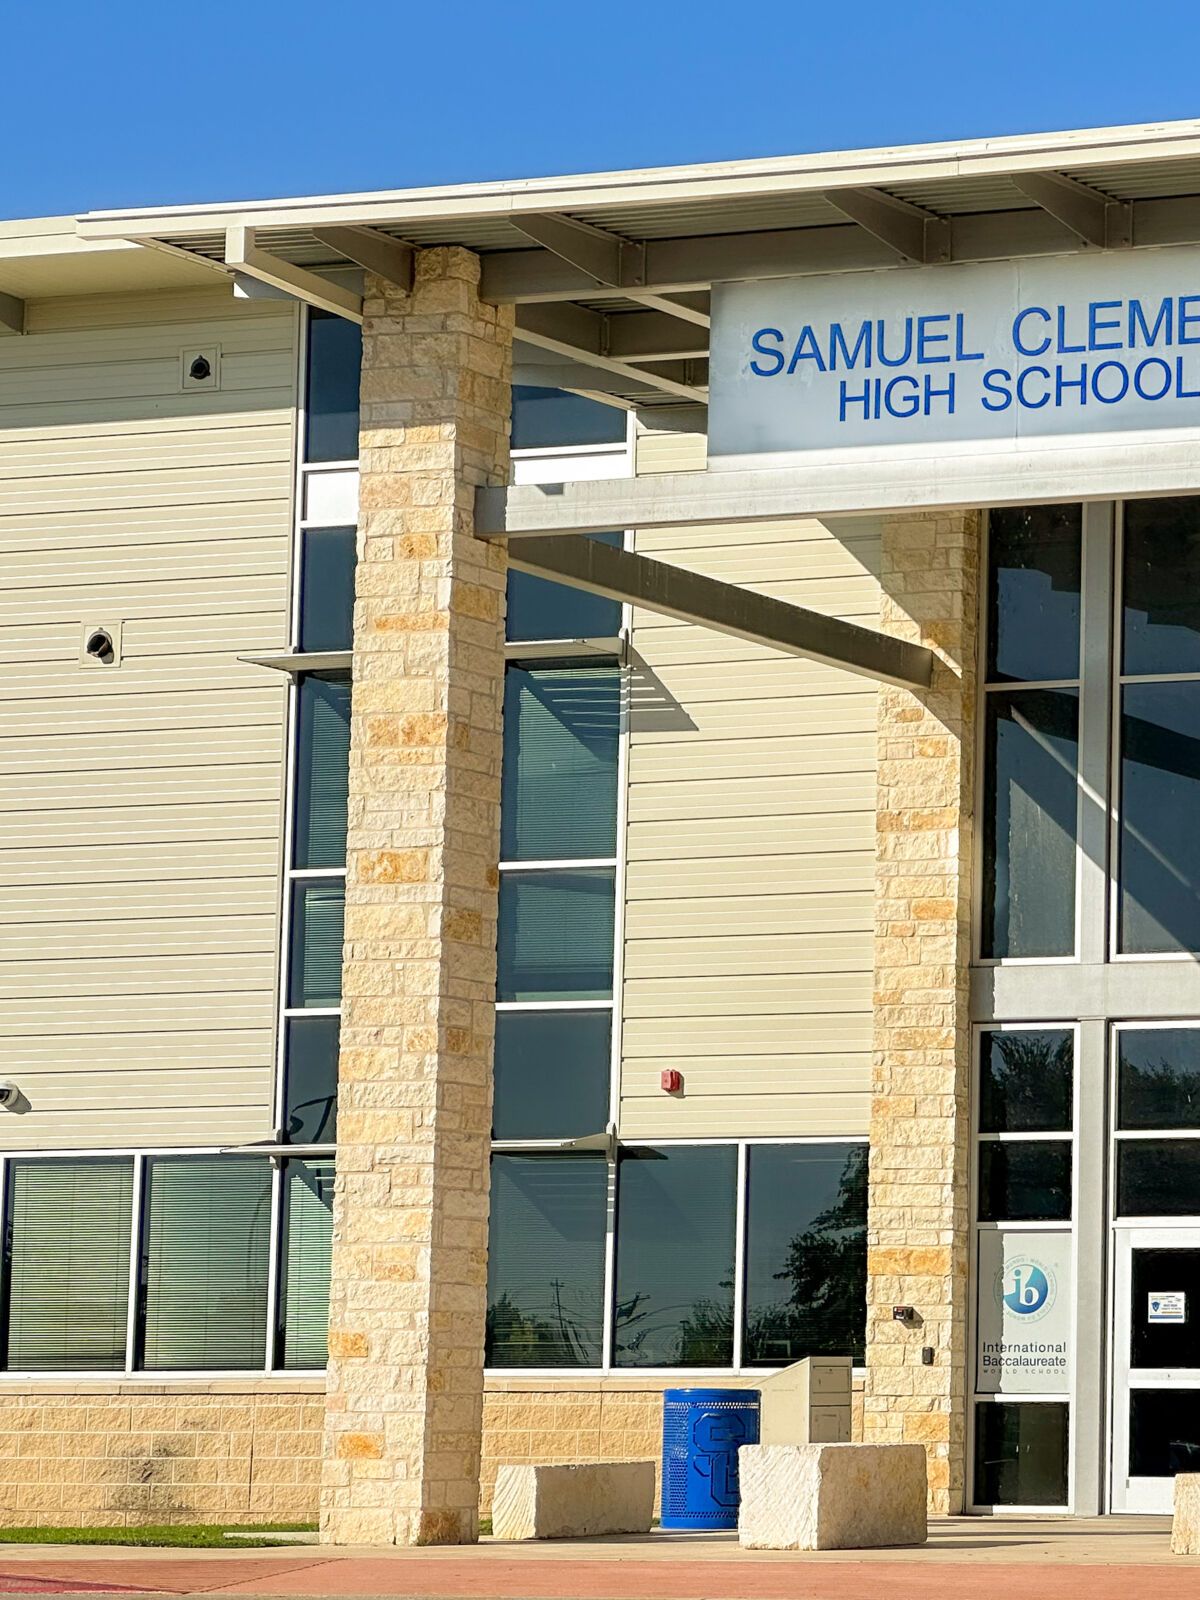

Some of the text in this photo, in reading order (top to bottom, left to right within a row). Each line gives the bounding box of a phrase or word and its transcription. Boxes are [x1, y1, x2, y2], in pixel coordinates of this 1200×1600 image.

[750, 313, 984, 377] SAMUEL
[839, 373, 956, 422] HIGH
[983, 1342, 1066, 1353] International
[983, 1355, 1067, 1367] Baccalaureate
